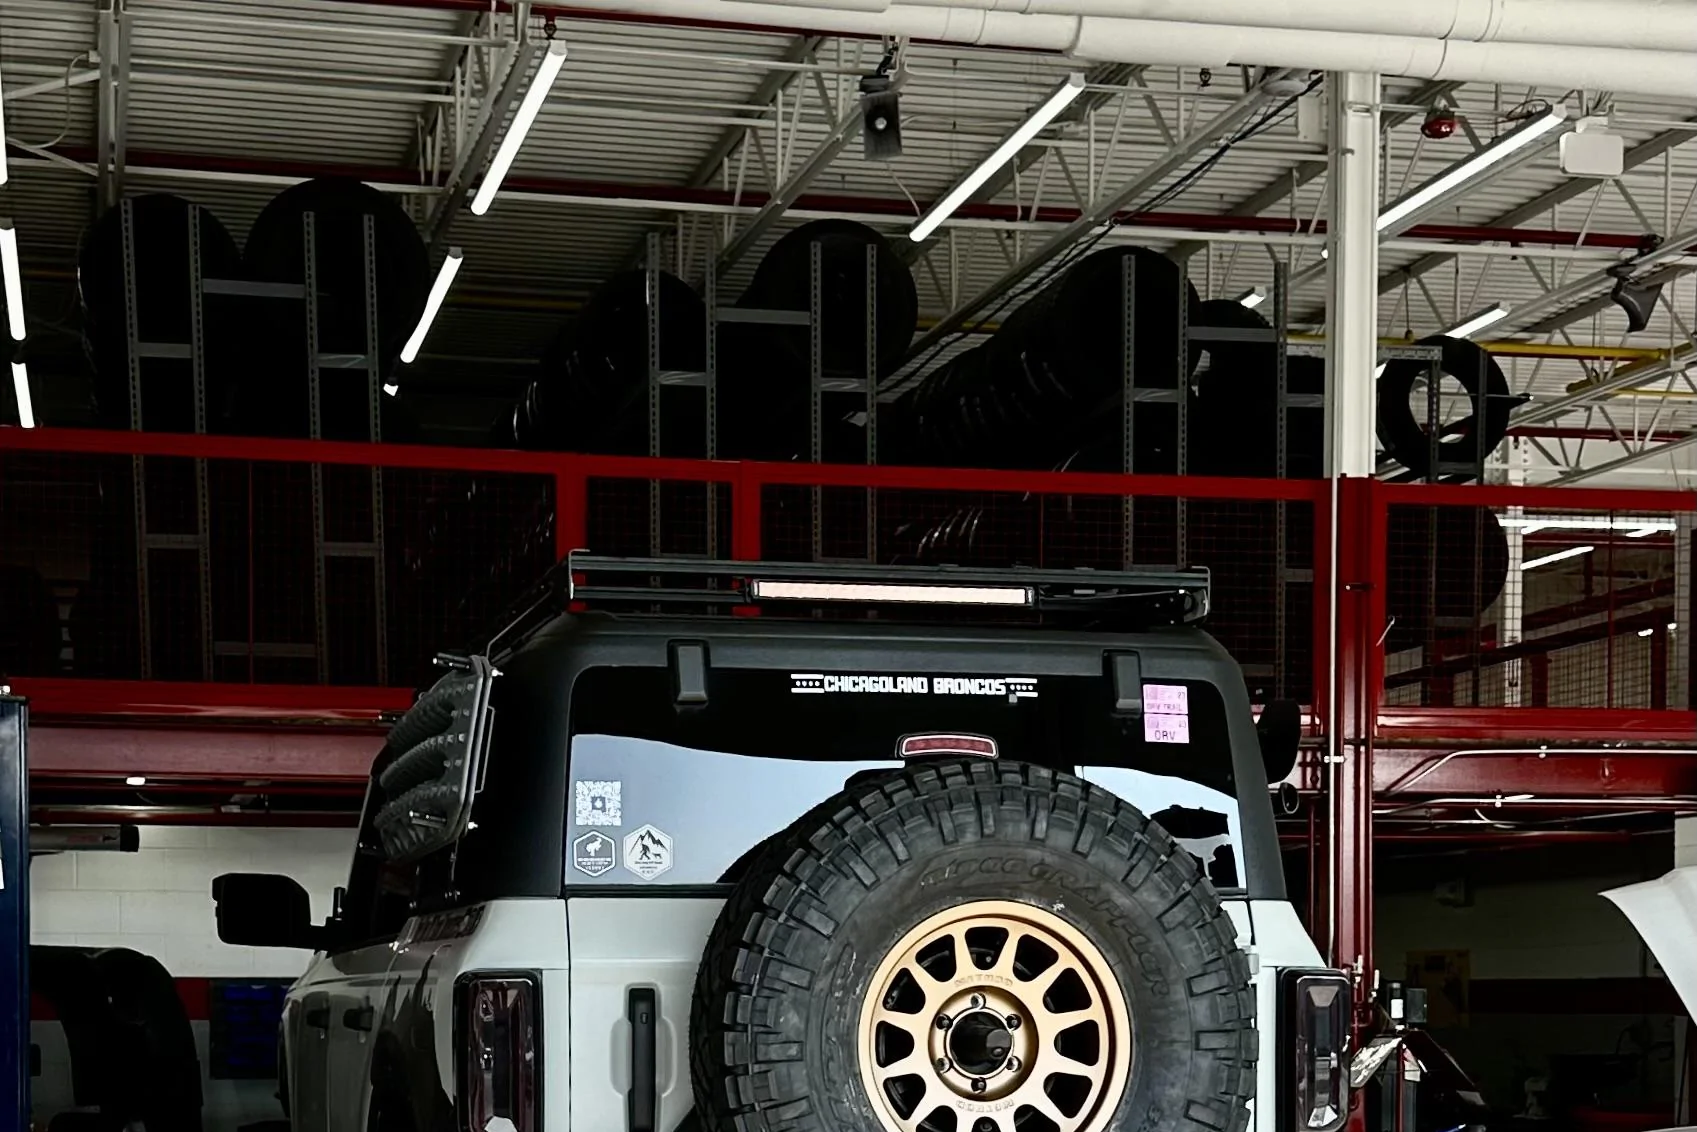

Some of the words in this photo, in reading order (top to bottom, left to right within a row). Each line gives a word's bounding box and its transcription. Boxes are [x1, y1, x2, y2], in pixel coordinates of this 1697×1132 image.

[823, 675, 928, 693] CHICAGOLAND
[933, 677, 1007, 695] BRONCOS
[1154, 730, 1176, 741] ORV
